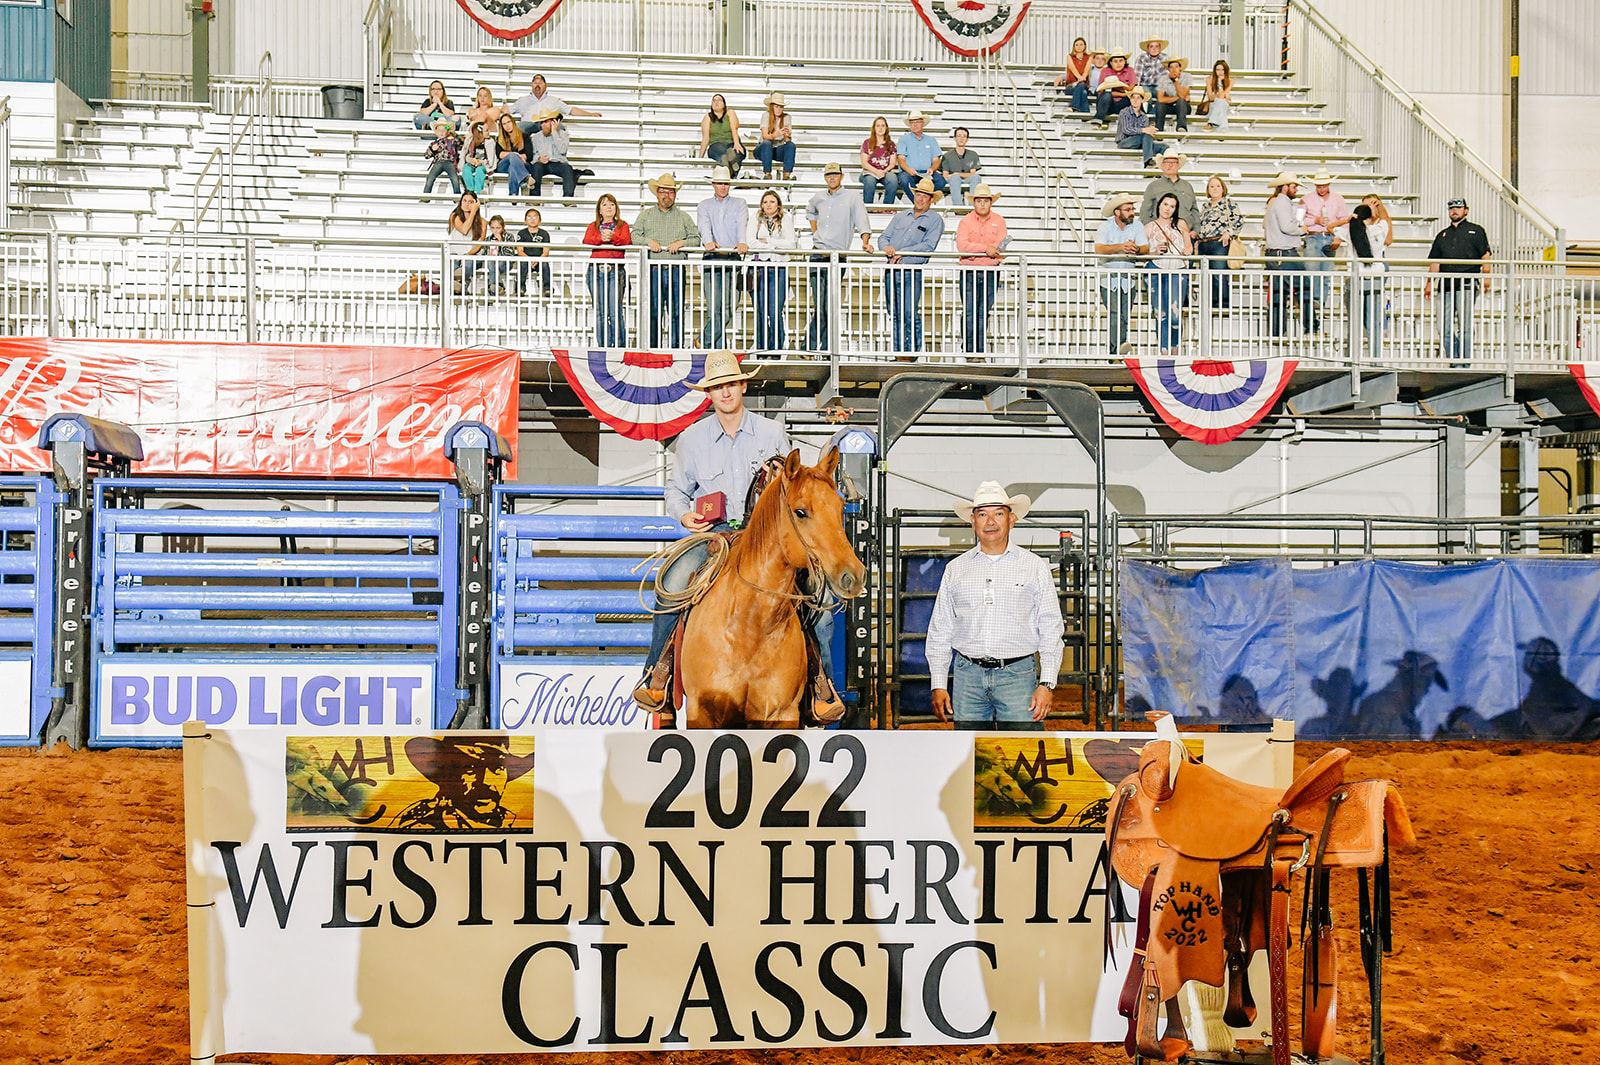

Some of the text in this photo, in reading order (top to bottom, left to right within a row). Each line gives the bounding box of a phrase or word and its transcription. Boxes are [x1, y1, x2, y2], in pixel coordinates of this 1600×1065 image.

[0, 353, 488, 449] Beiser
[62, 509, 82, 675] Priefert
[467, 514, 484, 676] Priefert
[855, 520, 869, 680] Prfert
[111, 675, 422, 726] BUD LIGHT
[645, 733, 867, 830] 2022
[211, 836, 1137, 930] WESTERN HERITA
[1152, 881, 1220, 916] TOP HAND
[1164, 928, 1208, 947] 2022
[501, 939, 998, 1048] CLASSIC
